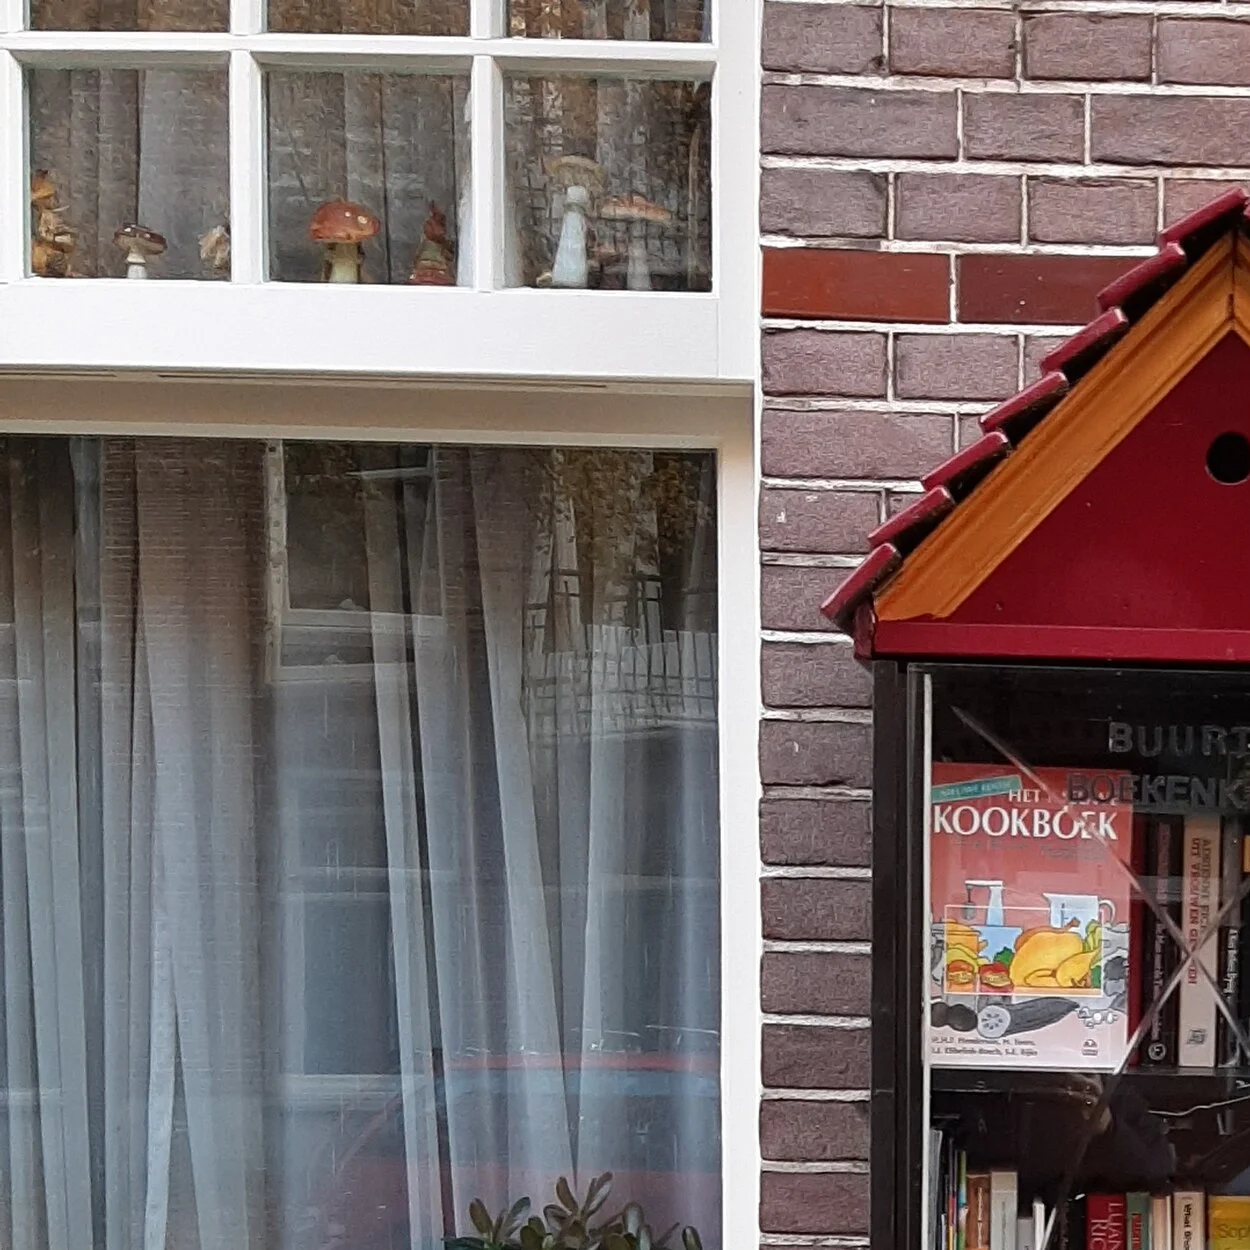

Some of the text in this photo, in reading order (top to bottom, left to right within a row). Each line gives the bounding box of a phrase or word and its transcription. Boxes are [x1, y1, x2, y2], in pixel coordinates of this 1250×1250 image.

[1008, 788, 1041, 803] HET
[933, 805, 1118, 840] KOOKBOEK
[1183, 1203, 1193, 1228] What
